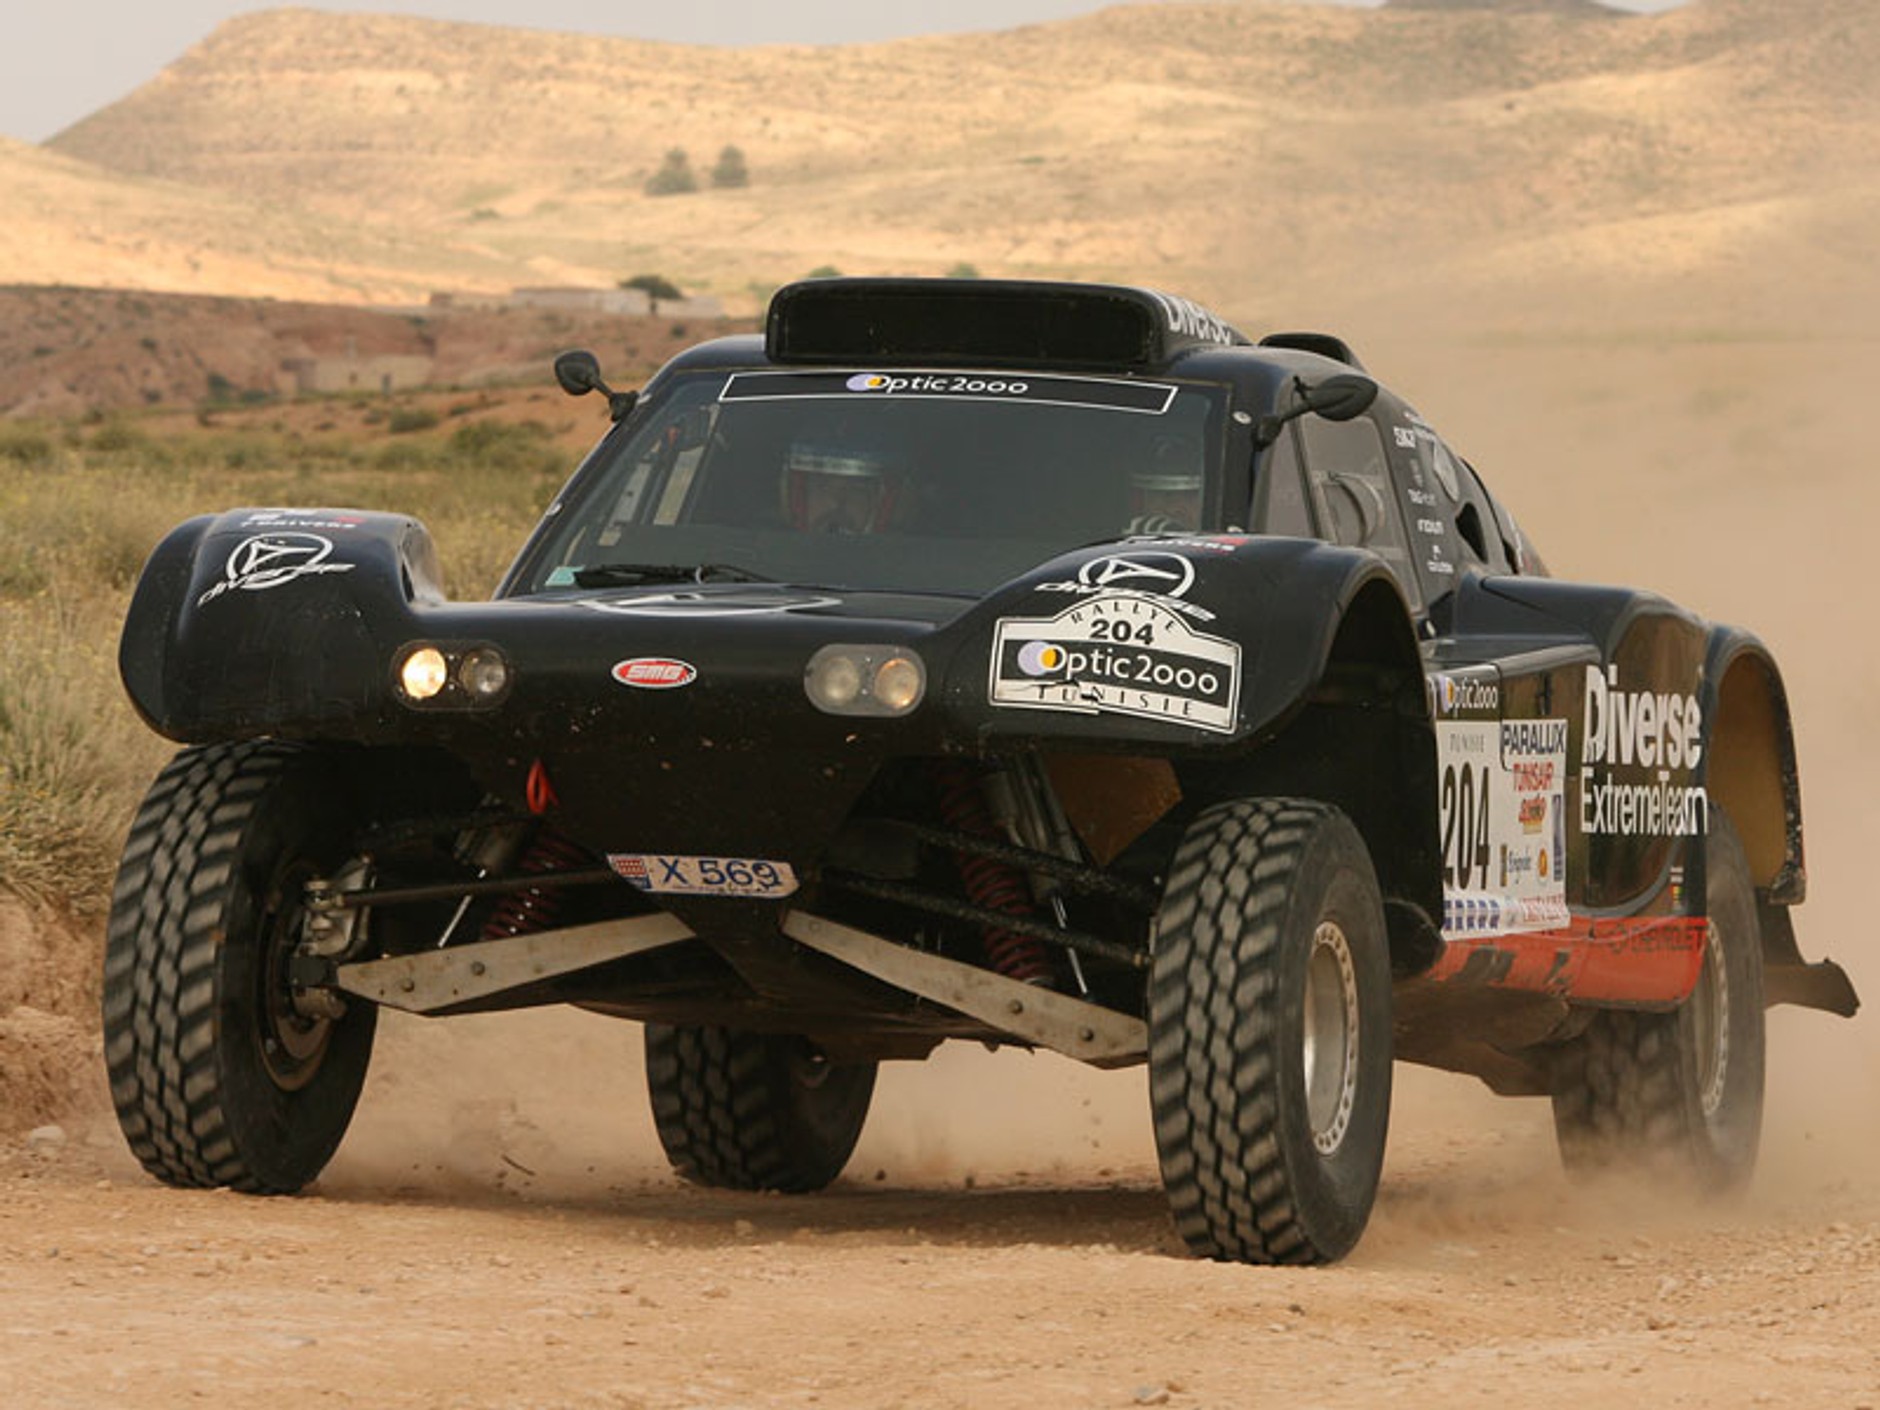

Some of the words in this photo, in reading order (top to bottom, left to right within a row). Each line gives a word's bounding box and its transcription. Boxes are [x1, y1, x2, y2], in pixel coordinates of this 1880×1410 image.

[1070, 601, 1176, 634] RALLYE
[1090, 619, 1154, 646] 204
[1037, 683, 1194, 717] TUNISIE
[1582, 664, 1702, 770] Diverse
[1441, 762, 1490, 890] 204
[658, 858, 689, 884] X
[698, 859, 782, 889] 569
